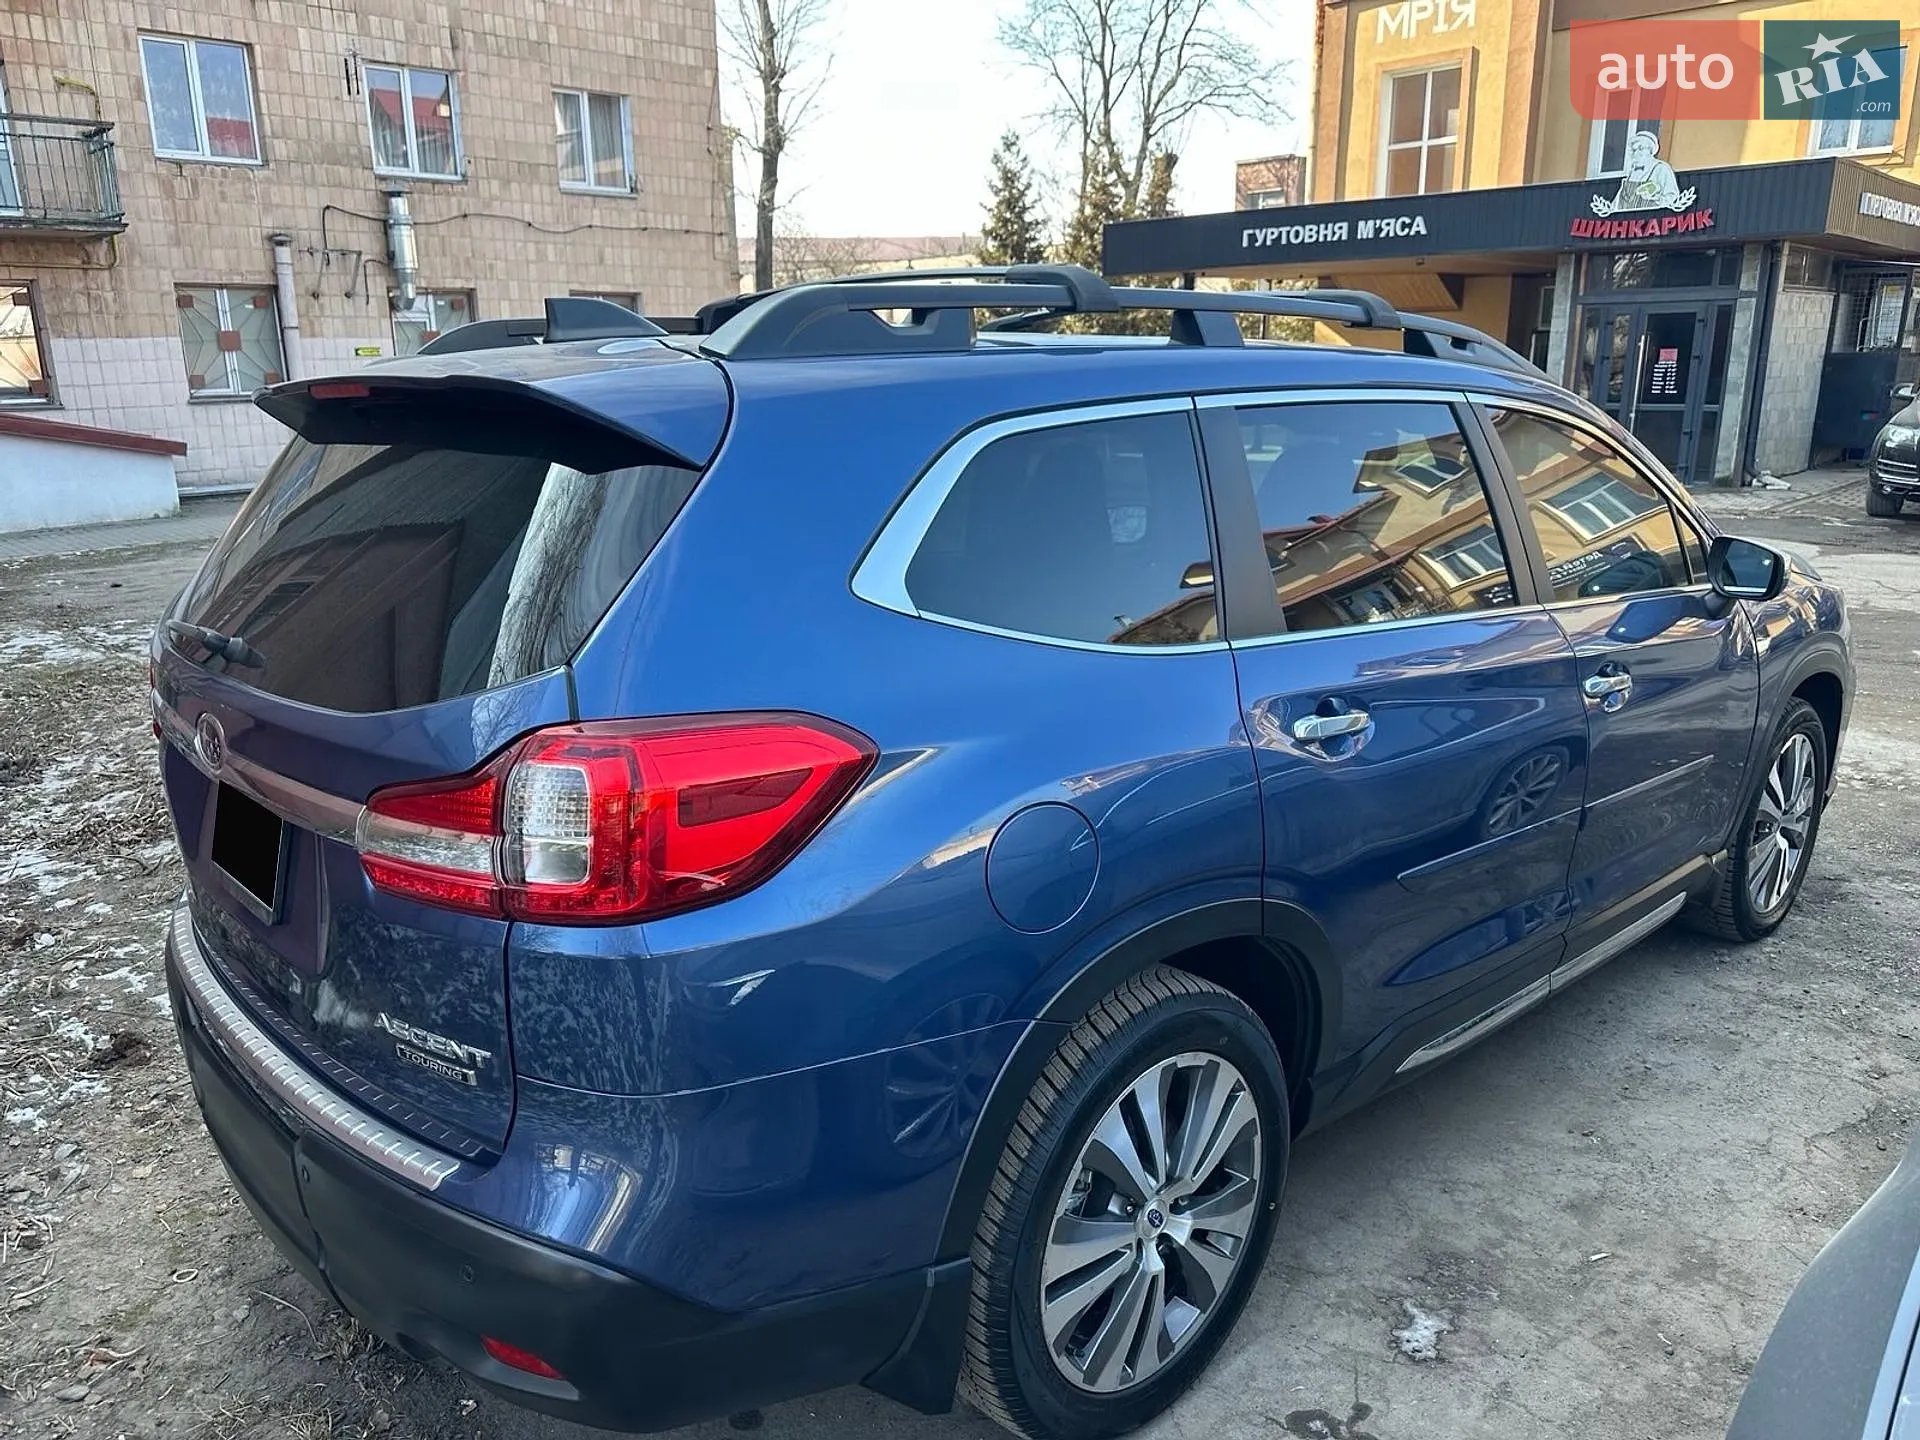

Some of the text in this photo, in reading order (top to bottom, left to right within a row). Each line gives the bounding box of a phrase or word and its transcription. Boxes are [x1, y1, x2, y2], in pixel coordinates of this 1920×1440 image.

[1376, 0, 1476, 44] МРІЯ
[1242, 215, 1428, 248] ГУРТОВНЯ М'ЯСА
[1570, 208, 1715, 239] ШИНКАРИК
[374, 1012, 491, 1068] ASCENT
[404, 1052, 462, 1080] TOURING
